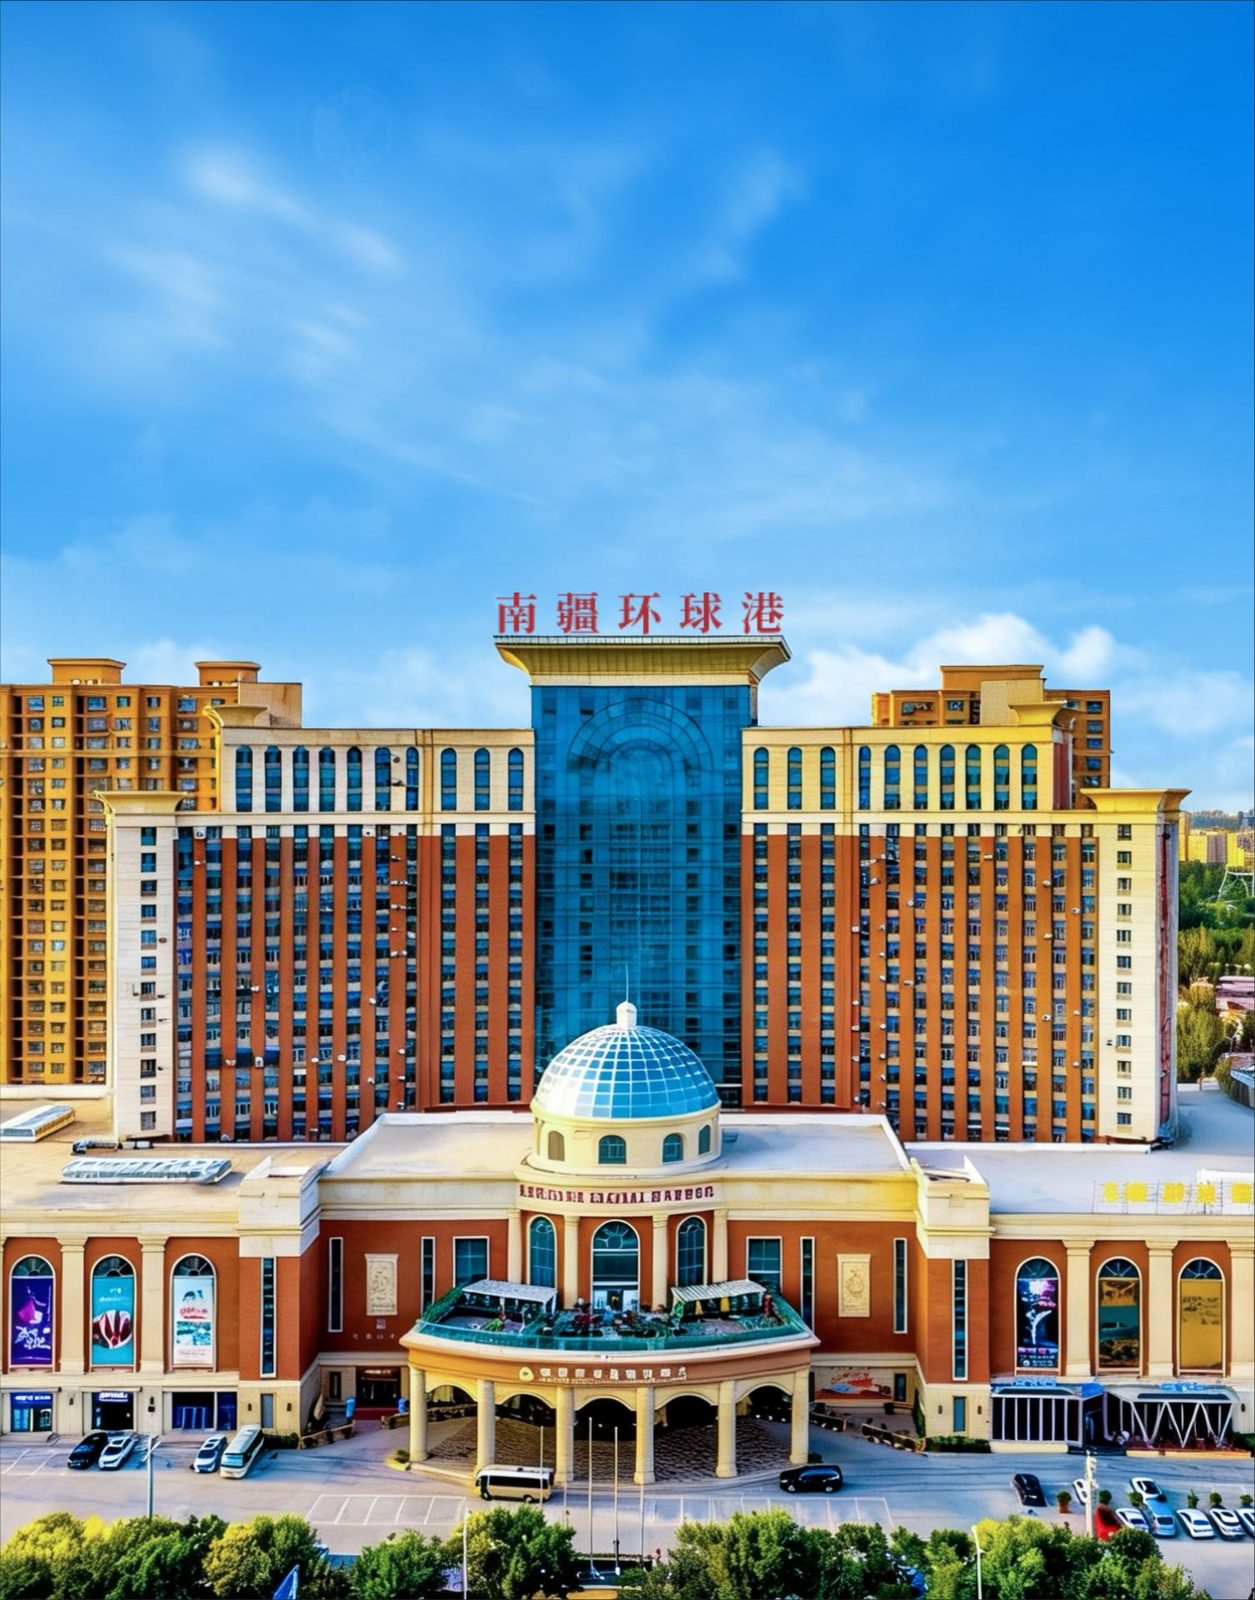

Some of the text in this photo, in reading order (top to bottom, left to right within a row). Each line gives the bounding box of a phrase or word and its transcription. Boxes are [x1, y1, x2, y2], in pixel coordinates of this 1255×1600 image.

[496, 591, 785, 635] 南疆环球港
